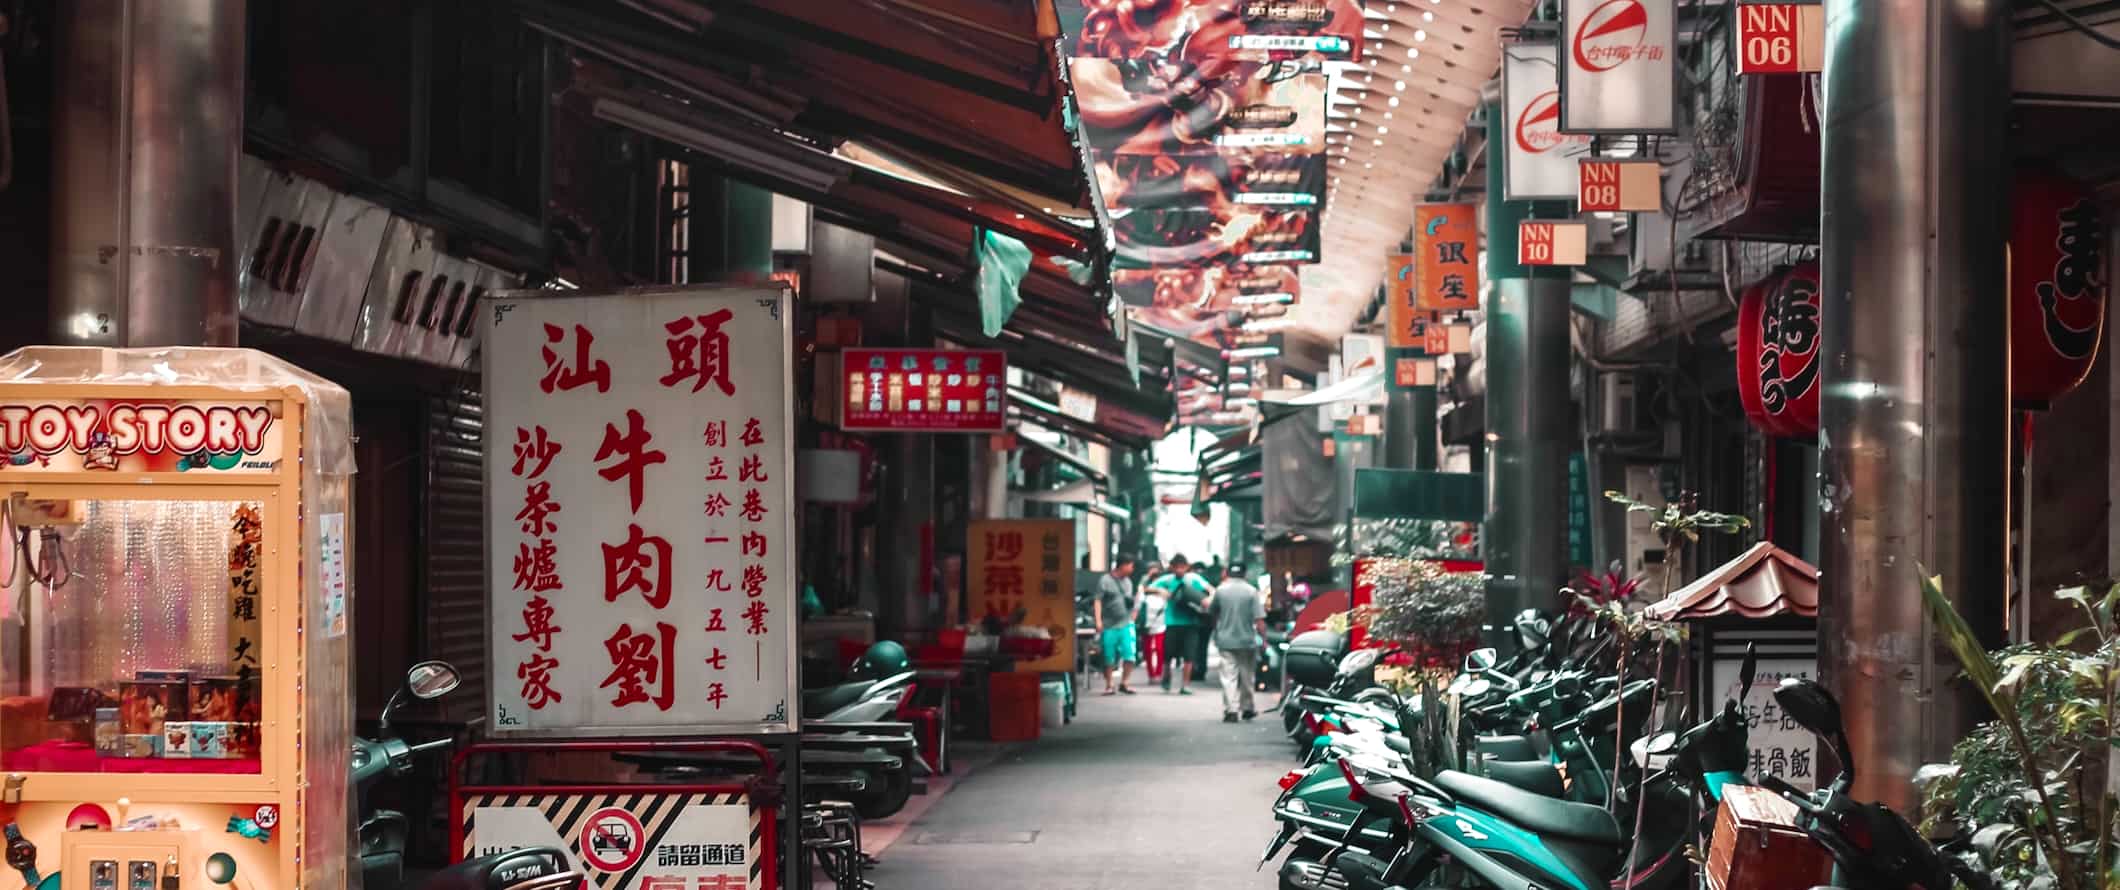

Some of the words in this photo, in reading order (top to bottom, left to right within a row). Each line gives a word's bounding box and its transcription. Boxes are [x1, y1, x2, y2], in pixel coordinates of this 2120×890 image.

[1746, 5, 1792, 32] NN
[1748, 36, 1791, 65] 06
[1584, 163, 1616, 182] NN
[1584, 186, 1616, 205] 08
[1525, 224, 1550, 241] NN
[1527, 244, 1548, 260] 10
[1437, 241, 1468, 300] 銀座
[0, 405, 100, 453] TOY
[108, 405, 272, 454] STORY
[512, 424, 563, 710] 沙茶爐專家
[593, 409, 677, 711] 牛肉劉
[703, 420, 732, 710] 創立於一九五七年
[657, 844, 745, 867] 請留通道
